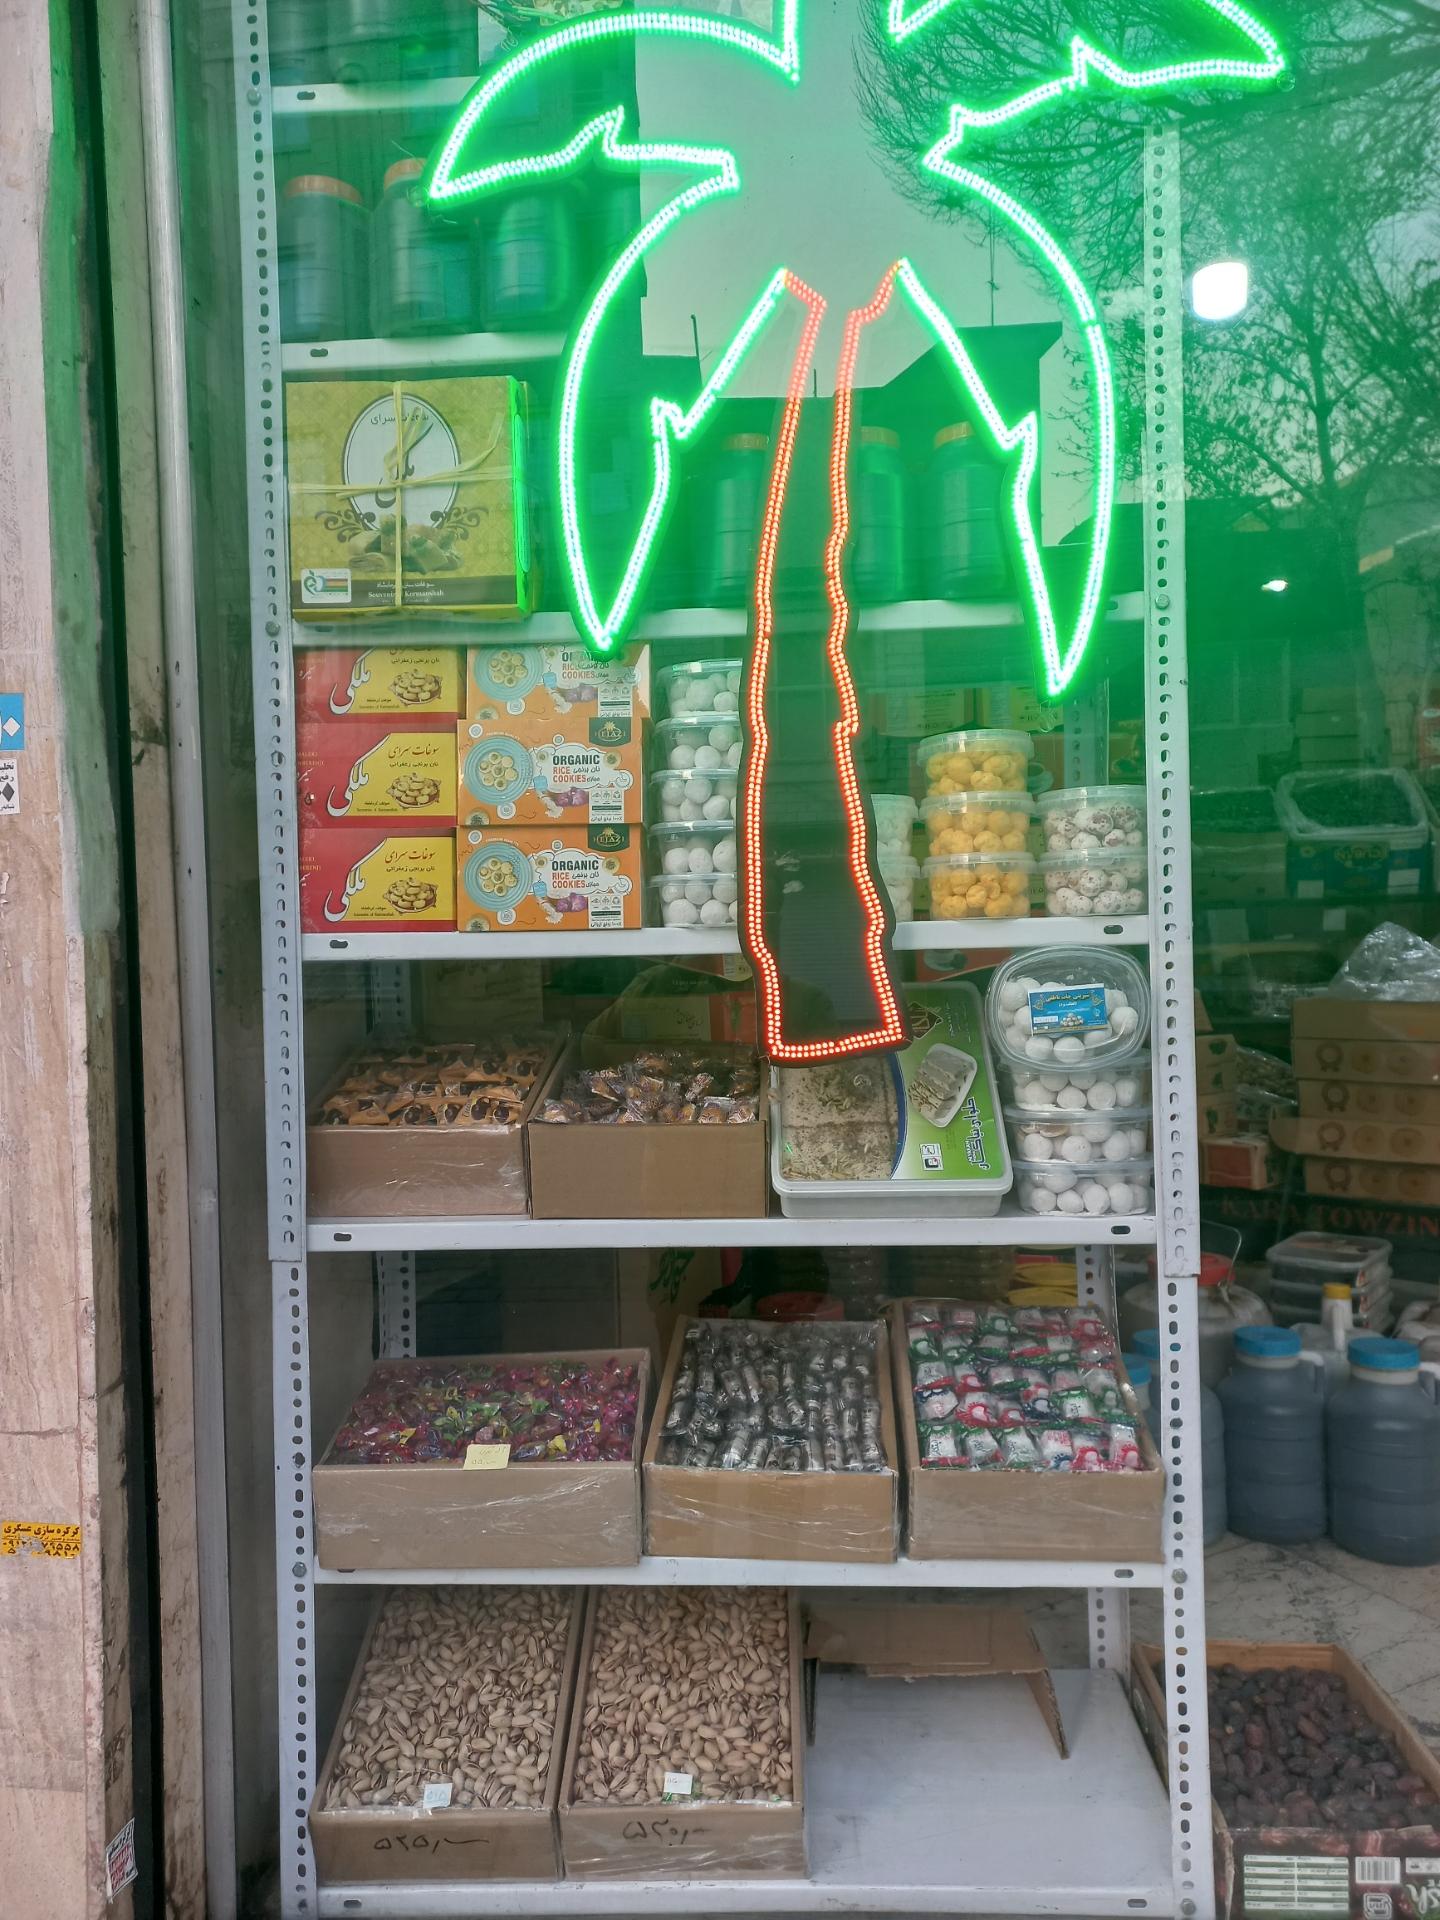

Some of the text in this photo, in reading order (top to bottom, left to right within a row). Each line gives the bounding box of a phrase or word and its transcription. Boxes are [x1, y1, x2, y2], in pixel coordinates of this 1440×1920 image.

[370, 413, 396, 425] سرای
[388, 743, 440, 759] سوغات سرای
[552, 754, 600, 766] ORGANIC
[552, 766, 571, 775] RICE
[552, 774, 586, 783] COOKIES
[384, 847, 437, 864] سوغات سرای
[552, 859, 599, 871] ORGANIC
[552, 871, 570, 880] RICE
[552, 879, 586, 889] COOKIES
[34, 1525, 55, 1536] سازی
